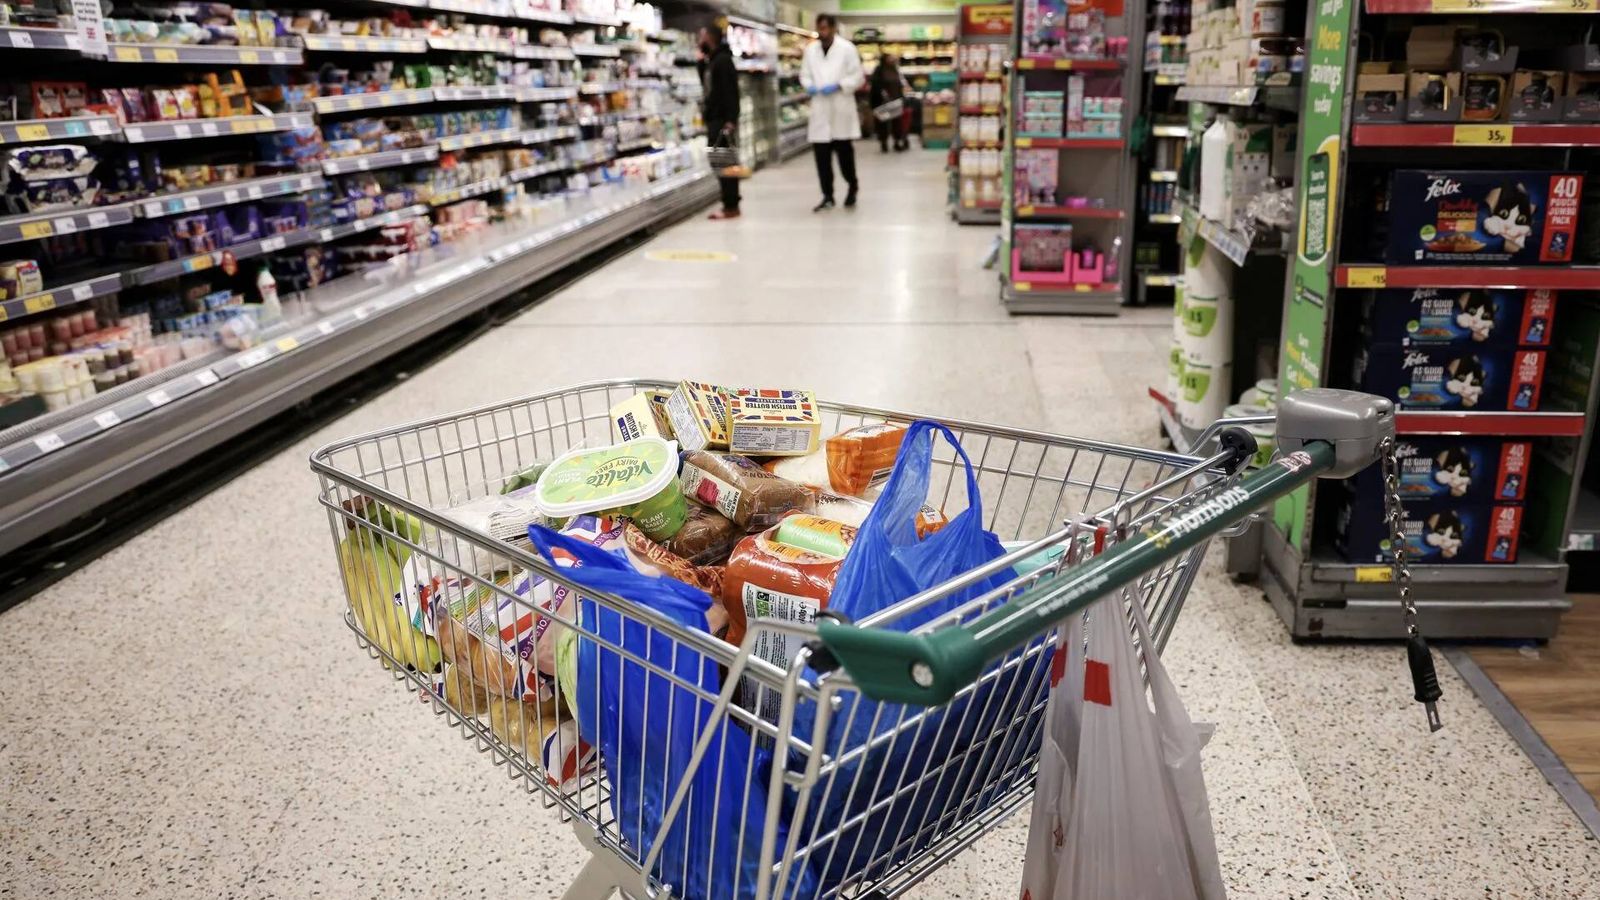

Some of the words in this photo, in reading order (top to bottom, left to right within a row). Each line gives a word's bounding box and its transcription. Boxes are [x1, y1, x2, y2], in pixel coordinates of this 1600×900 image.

[1487, 130, 1506, 142] 35p
[1554, 177, 1578, 198] 40
[586, 460, 653, 488] Vitalite
[640, 511, 664, 524] PLANT
[1162, 485, 1250, 538] Morrisons
